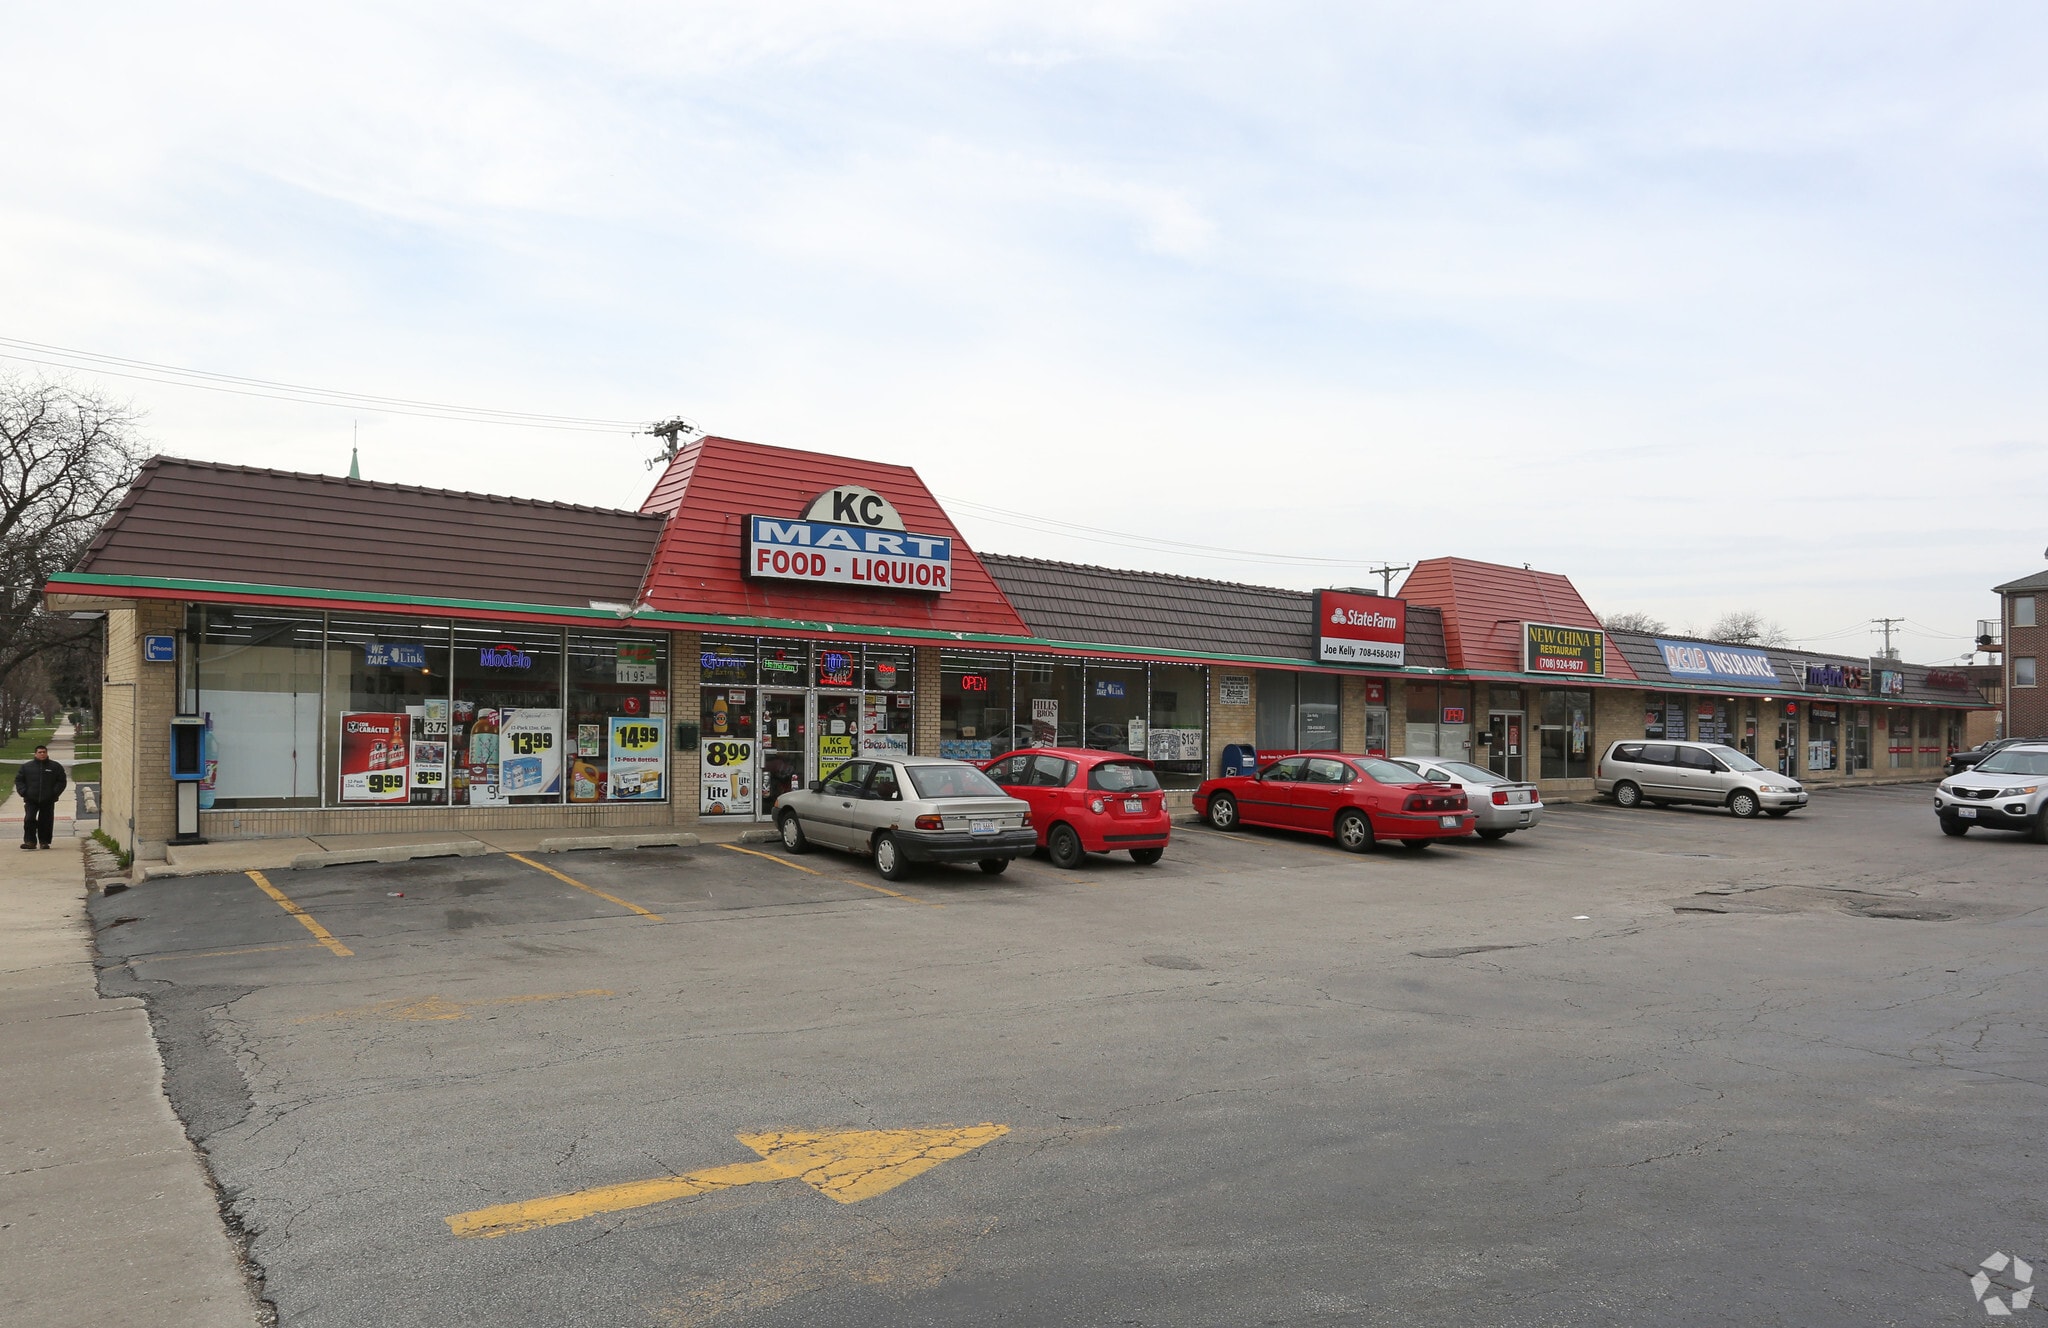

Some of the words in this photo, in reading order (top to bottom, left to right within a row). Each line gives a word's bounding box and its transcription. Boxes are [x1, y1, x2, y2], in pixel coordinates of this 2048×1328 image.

[833, 491, 884, 526] KC
[758, 521, 944, 558] MART
[758, 548, 826, 576] FOOD
[852, 558, 947, 587] LIQUIOR
[1530, 627, 1555, 643] NEW
[1557, 630, 1590, 646] CHINA
[371, 644, 384, 654] WE
[1324, 644, 1336, 654] Joe
[1338, 645, 1356, 658] Kelly
[1359, 648, 1401, 658] 708-458-0847
[1540, 644, 1582, 656] RESTAURANT
[368, 655, 388, 664] TAKE
[400, 653, 422, 663] Link
[480, 648, 531, 668] Modelo
[701, 653, 746, 670] Corona
[1540, 658, 1555, 670] (708)
[1664, 646, 1708, 670] NCIB
[1706, 651, 1776, 677] INSURANCE
[764, 660, 795, 671] Heineken
[829, 673, 847, 682] 7403
[962, 676, 987, 691] OPEN
[1034, 700, 1057, 710] HILLS
[425, 722, 447, 733] $3.75
[508, 732, 552, 754] $13.99
[616, 726, 658, 748] $14.99
[864, 738, 886, 749] Coors
[704, 742, 751, 766] $8.99
[366, 774, 403, 793] $9.99
[416, 772, 442, 784] $8.99
[739, 777, 750, 785] Lite
[707, 786, 728, 800] Lite
